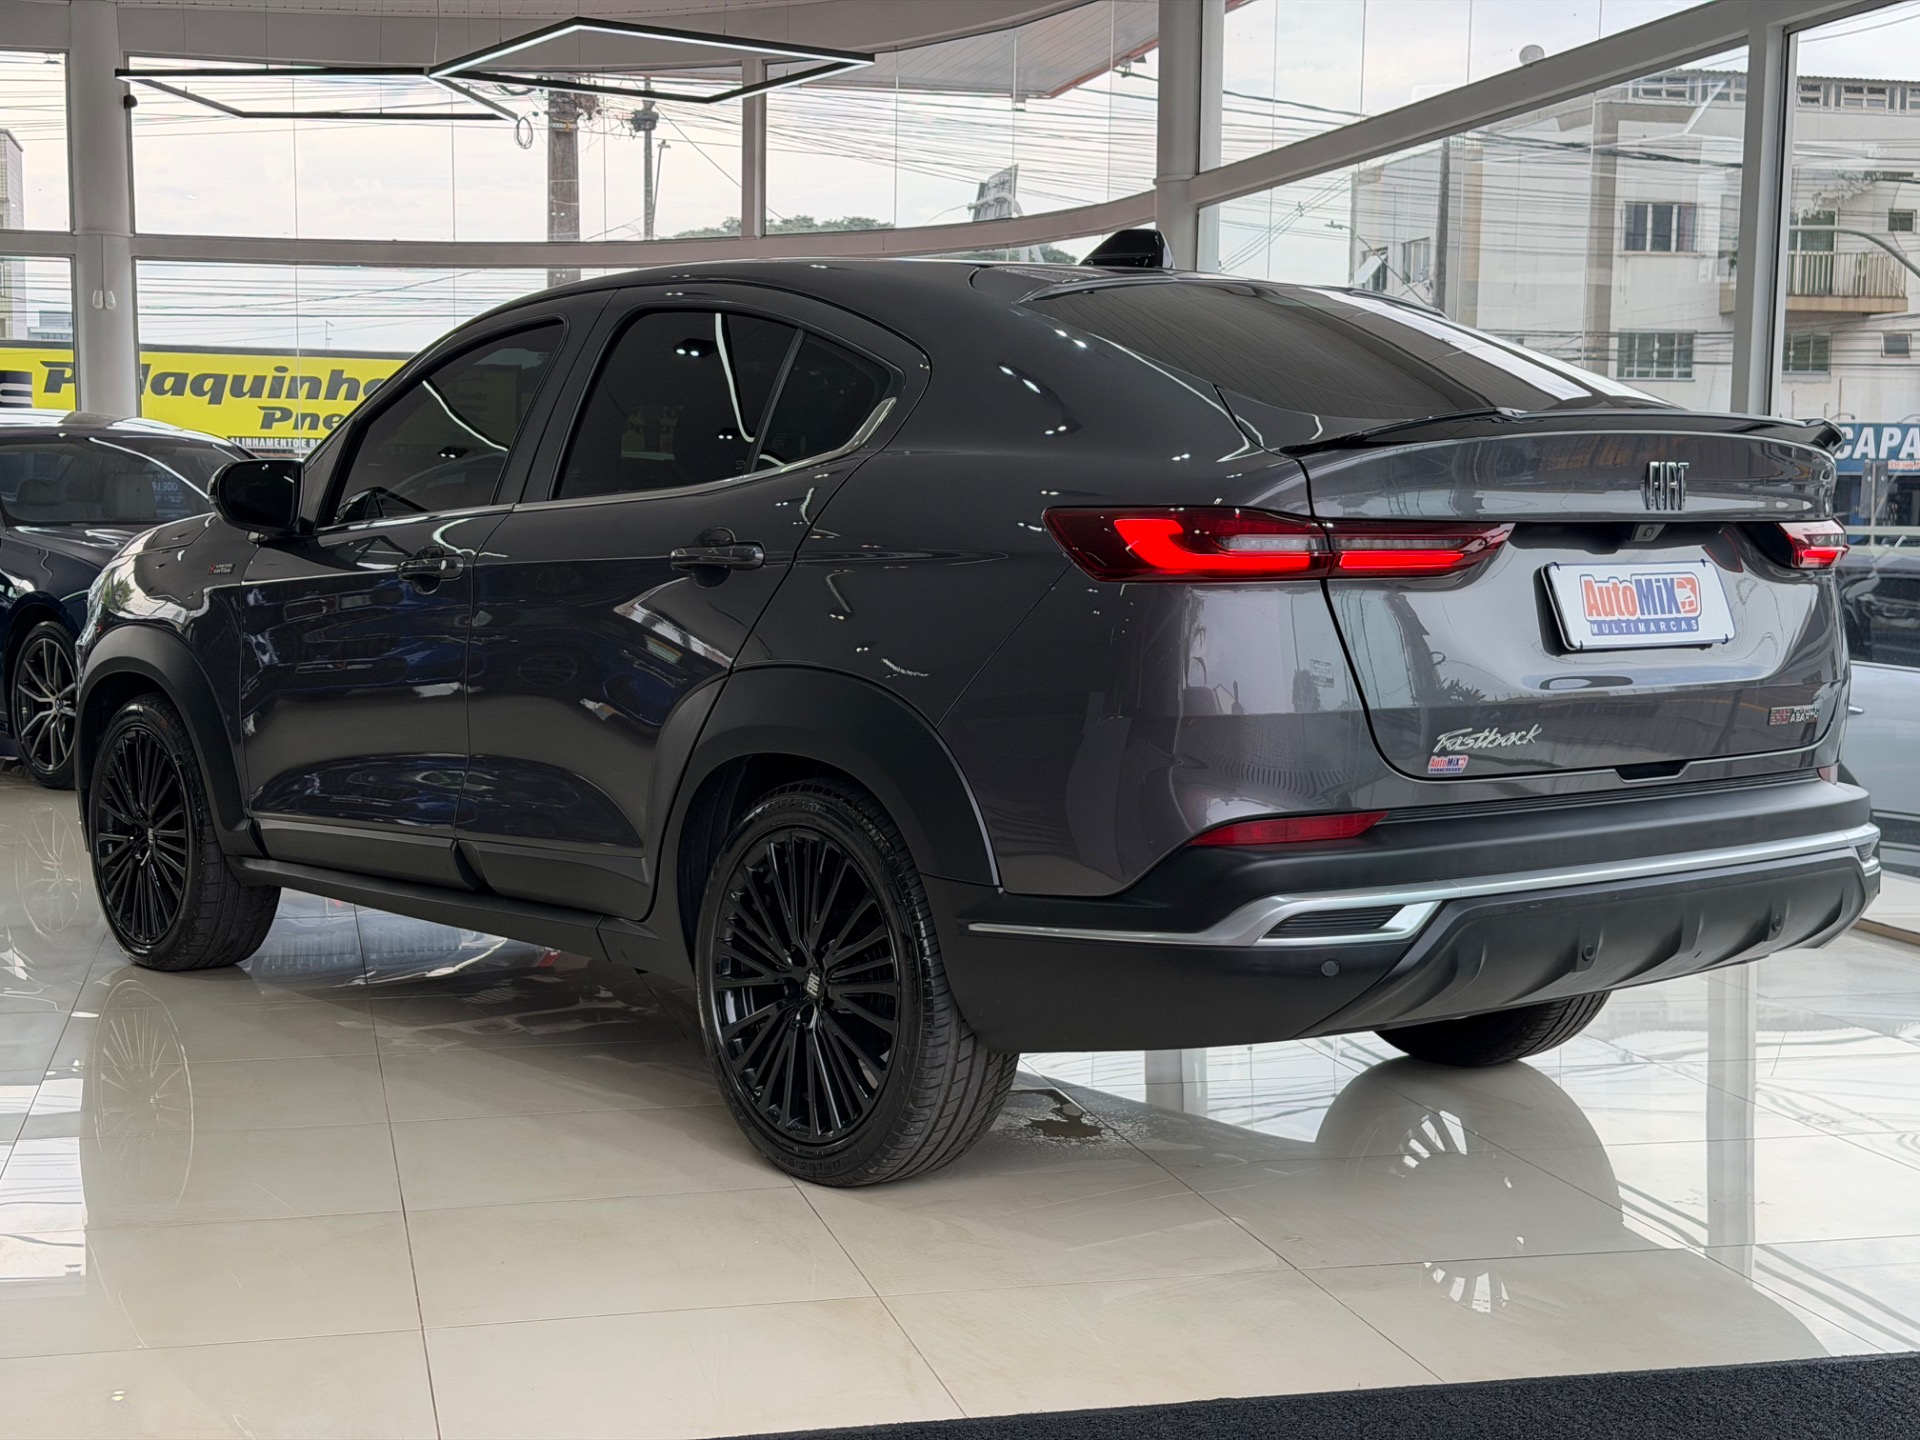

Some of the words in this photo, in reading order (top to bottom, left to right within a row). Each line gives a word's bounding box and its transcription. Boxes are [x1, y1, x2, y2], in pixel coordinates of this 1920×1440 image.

[302, 438, 308, 448] E
[1591, 620, 1698, 634] MULTIMARCAS
[1433, 723, 1542, 753] Fastback
